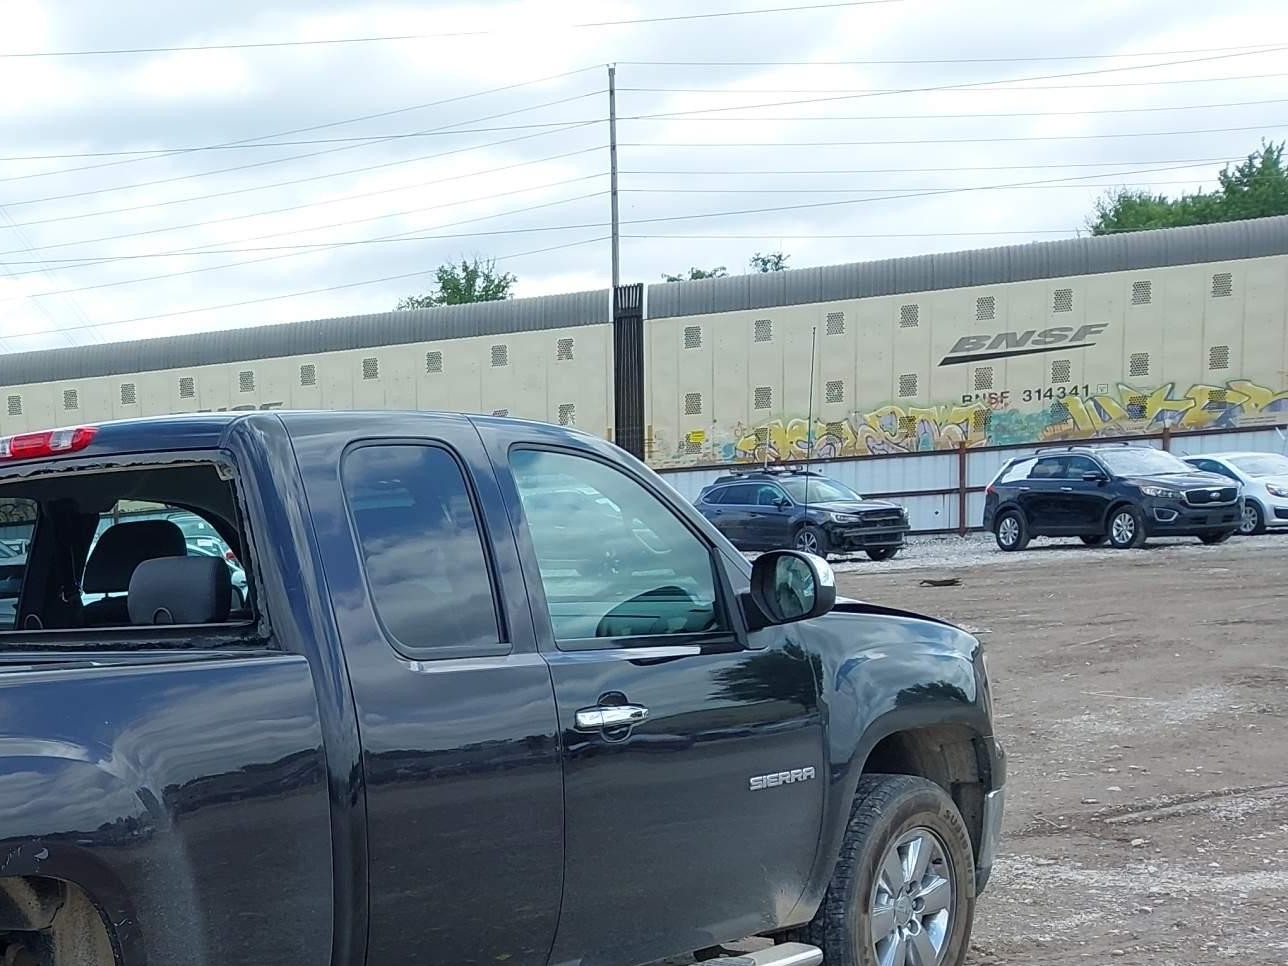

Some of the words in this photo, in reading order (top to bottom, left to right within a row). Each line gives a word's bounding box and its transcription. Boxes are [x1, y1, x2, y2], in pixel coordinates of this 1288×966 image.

[948, 323, 1109, 353] BNSF
[1022, 384, 1090, 402] 314341
[750, 766, 815, 791] SIERRA
